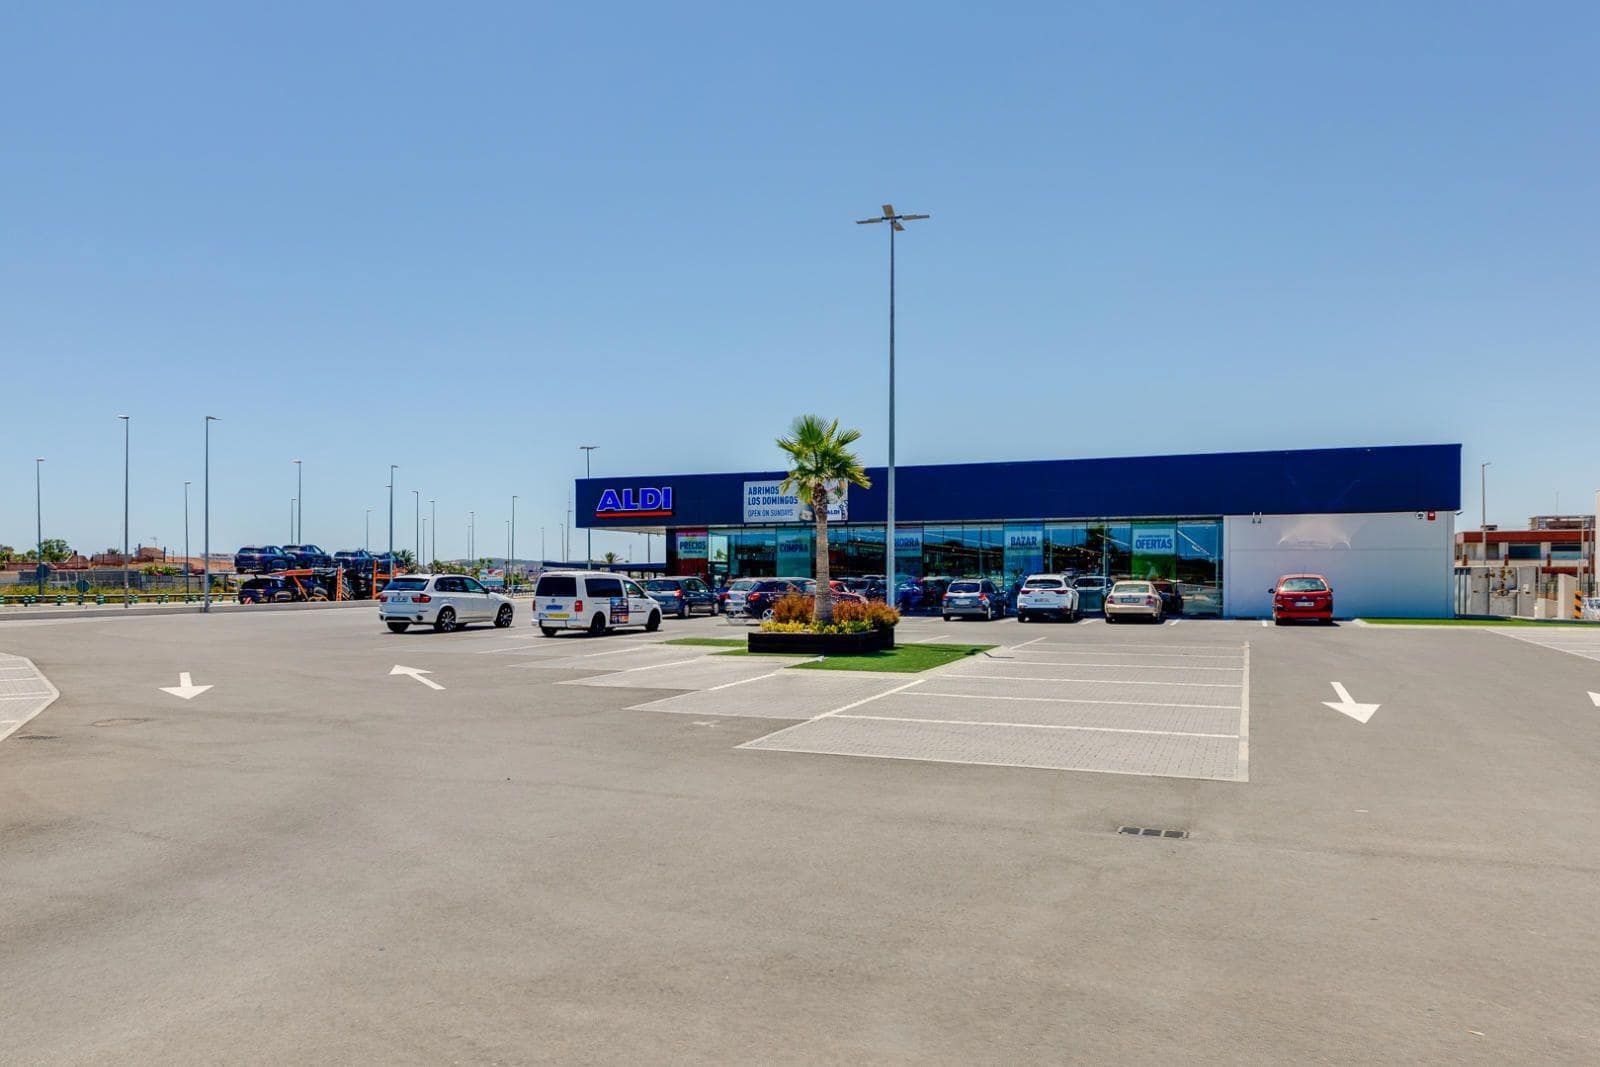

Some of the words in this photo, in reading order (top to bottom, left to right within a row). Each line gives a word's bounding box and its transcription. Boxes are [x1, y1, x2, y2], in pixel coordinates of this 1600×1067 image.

[748, 487, 779, 495] ABRIMOS
[596, 487, 672, 511] ALDI
[748, 497, 761, 505] LOS
[762, 496, 798, 505] DOMINGOS
[748, 509, 761, 517] OPEN
[762, 509, 770, 517] ON
[771, 508, 794, 517] SUNDAYS
[1010, 536, 1037, 546] BAZAR
[1135, 538, 1173, 549] OFERTAS
